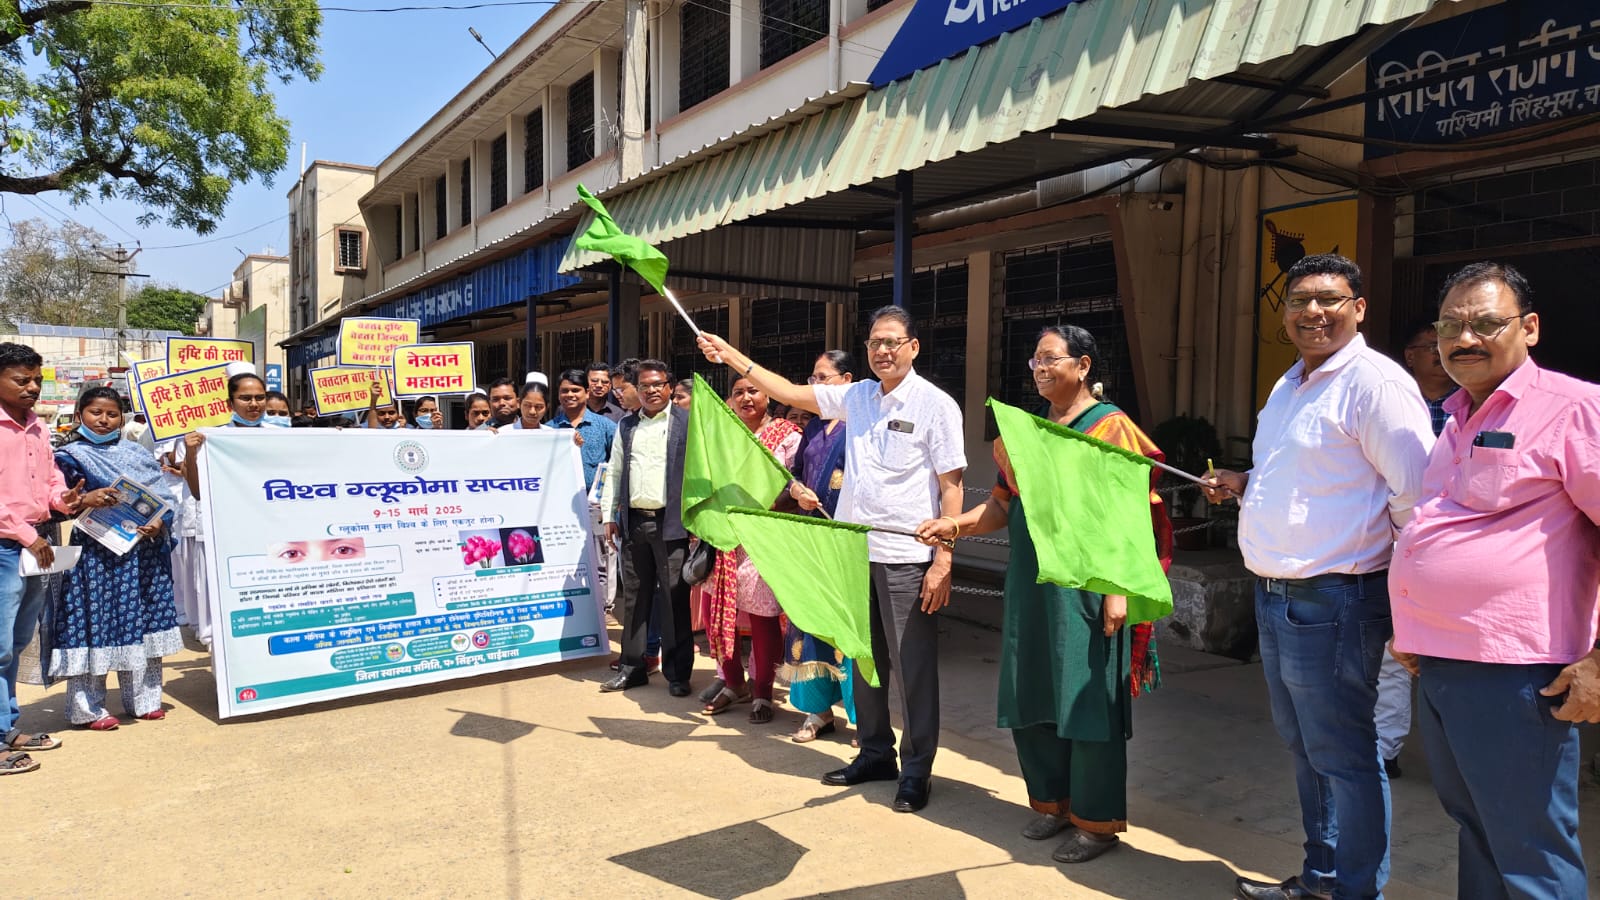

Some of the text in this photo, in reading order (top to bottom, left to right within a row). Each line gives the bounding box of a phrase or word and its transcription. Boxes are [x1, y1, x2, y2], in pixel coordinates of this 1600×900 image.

[1436, 101, 1503, 137] पश्चिमी
[178, 344, 244, 364] दृष्टि की रक्षा
[407, 352, 460, 368] नेत्रदान
[406, 374, 463, 389] महादान
[149, 386, 172, 410] दृष्टि
[172, 382, 182, 400] है
[183, 379, 194, 397] तो
[196, 376, 225, 395] जीवन
[323, 391, 352, 405] नेत्रदान
[353, 389, 368, 402] एक
[153, 398, 232, 428] वर्ना दुनिया अंधेर
[263, 475, 542, 503] विश्व ग्लूकोमा सप्ताह
[373, 503, 463, 518] 9-15 मार्च 2025
[339, 523, 370, 534] ग्लूकोमा
[375, 523, 393, 533] मुक्त
[397, 519, 416, 529] विश्व
[421, 518, 428, 528] के
[433, 518, 448, 527] लिए
[355, 669, 380, 682] जिला
[380, 665, 412, 678] स्वास्थ्य
[487, 649, 520, 661] चाईबासा
